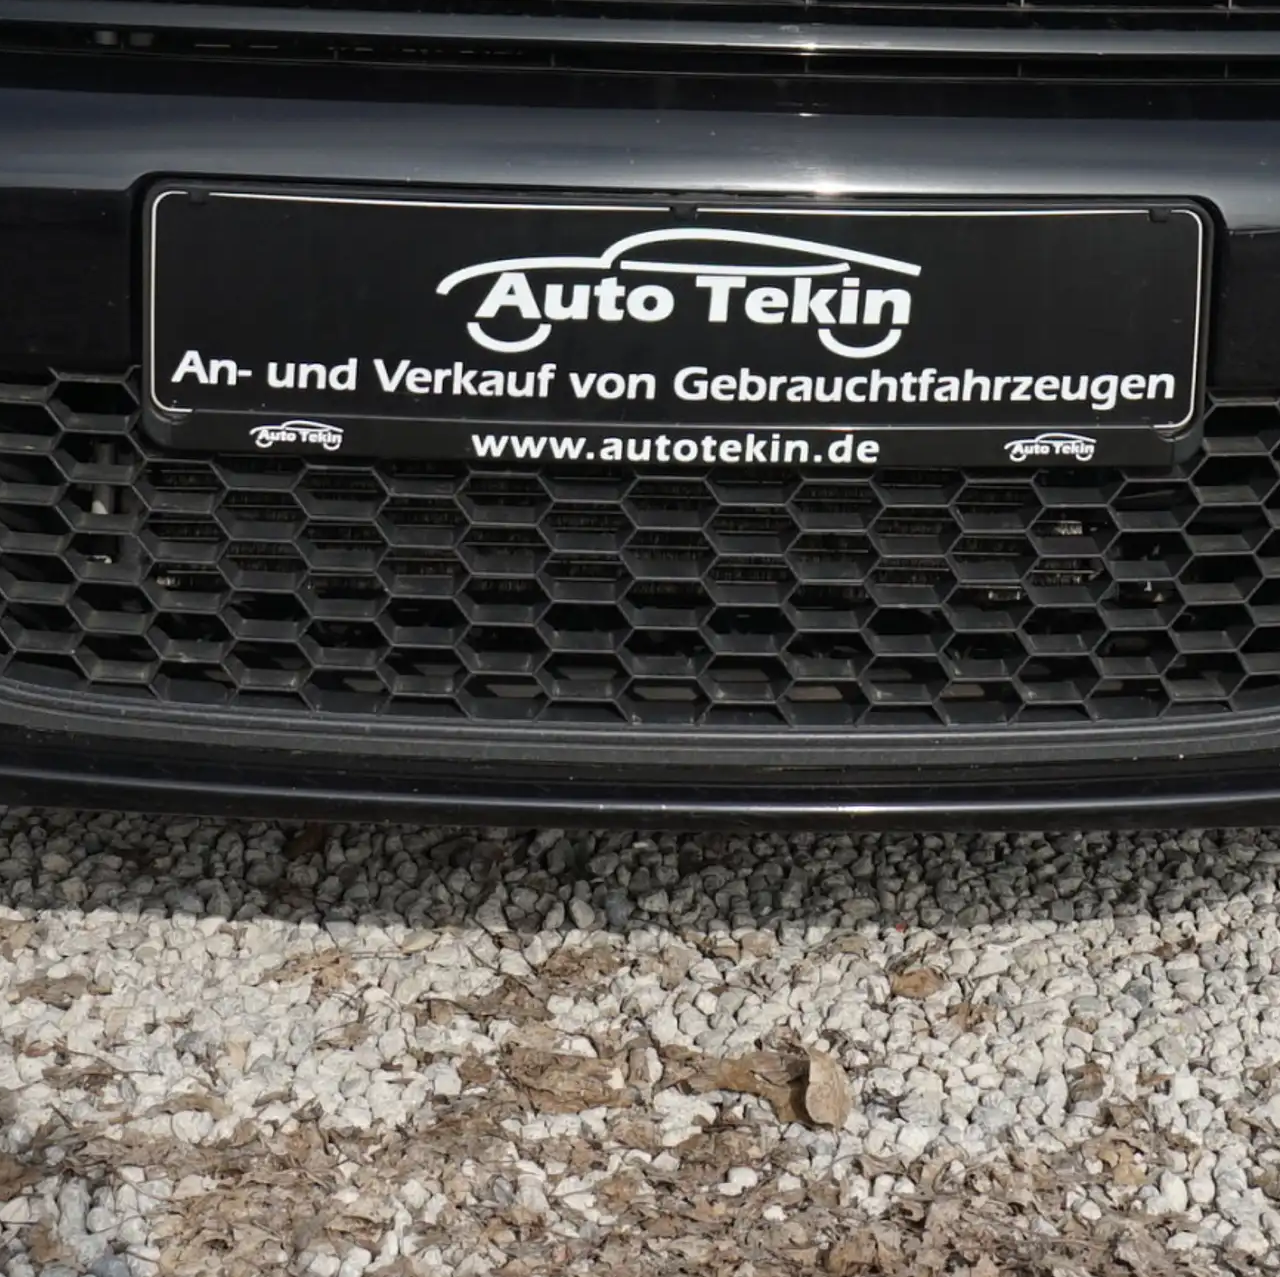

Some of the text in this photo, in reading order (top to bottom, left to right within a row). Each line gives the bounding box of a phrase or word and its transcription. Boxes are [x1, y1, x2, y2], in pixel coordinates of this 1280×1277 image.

[474, 272, 913, 328] Auto Tekin
[171, 350, 1175, 412] An- und Verkauf von Gebrauchtfahrzeugen
[256, 429, 342, 444] Auto Tekin
[471, 432, 880, 466] www.autotekin.de
[1011, 441, 1095, 455] Auto Tekin
